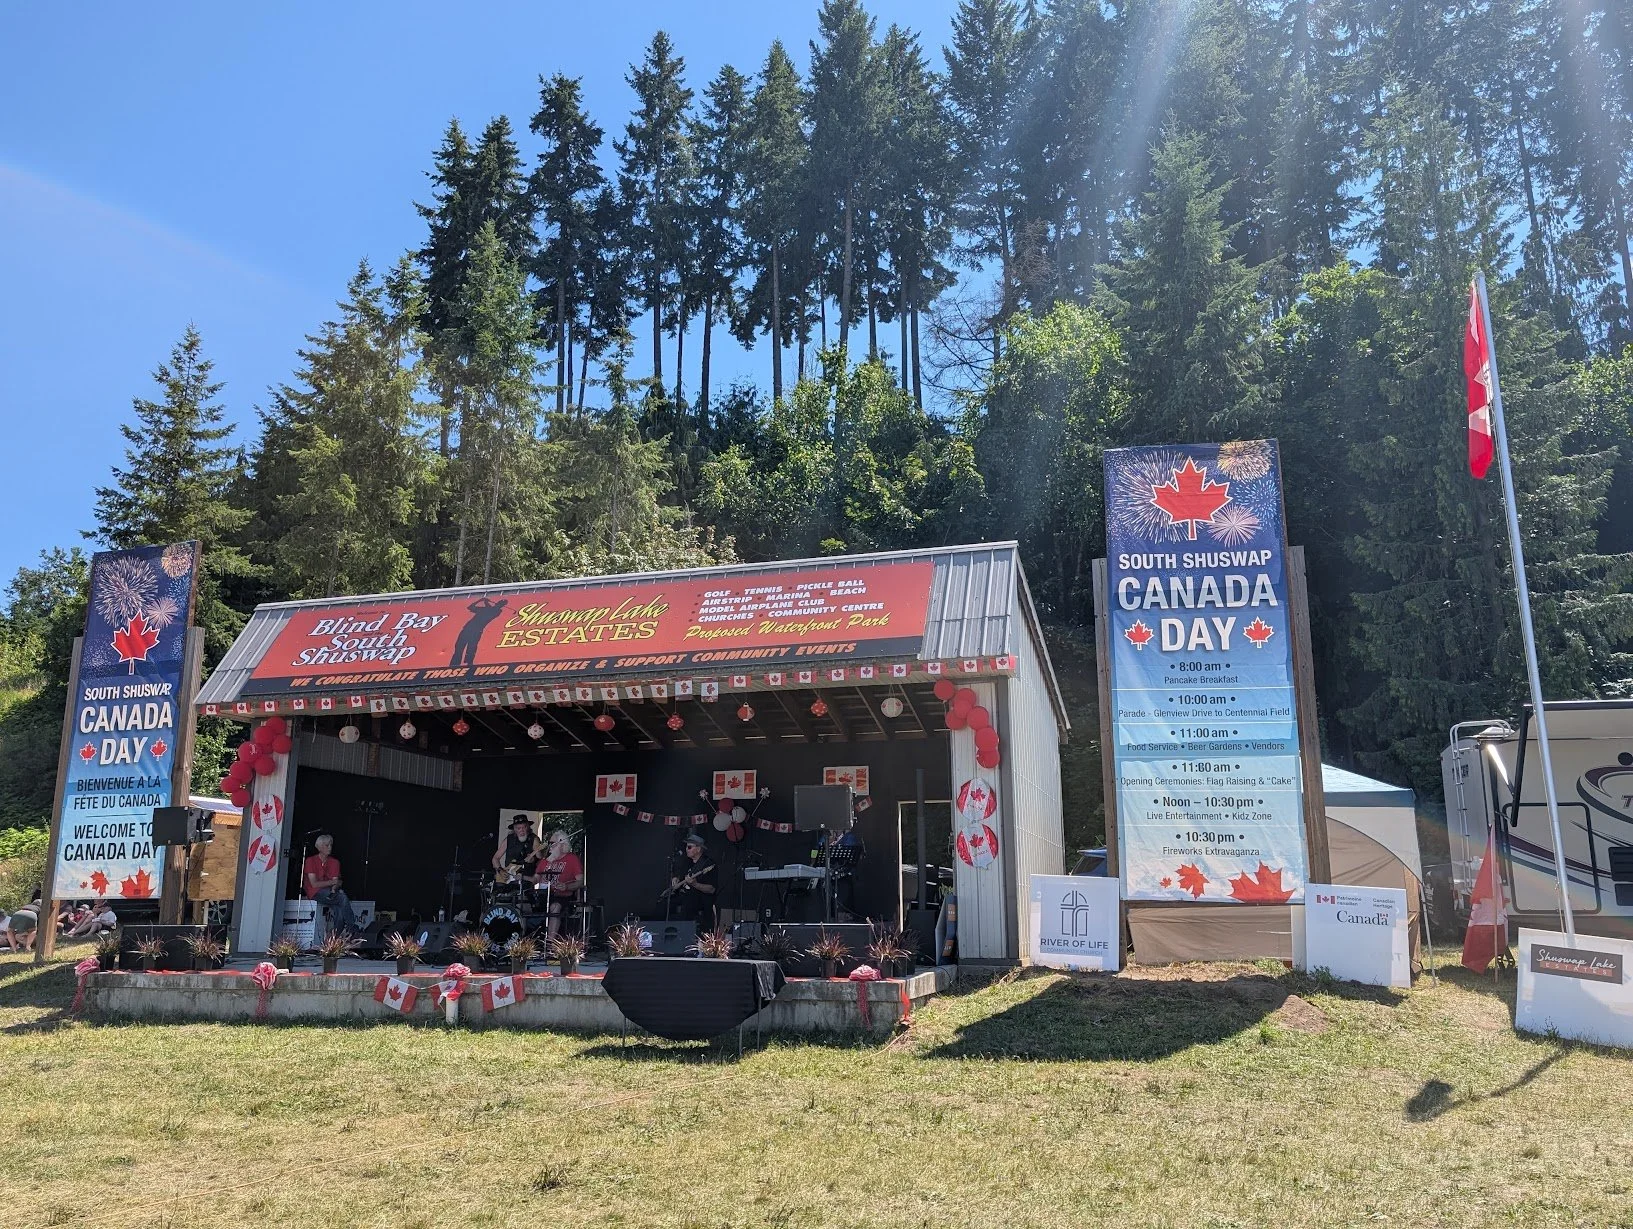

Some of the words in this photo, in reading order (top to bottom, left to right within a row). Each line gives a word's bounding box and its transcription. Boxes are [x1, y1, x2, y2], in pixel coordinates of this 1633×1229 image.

[1119, 553, 1177, 570] SOUTH
[1183, 550, 1272, 569] SHUSWAP
[702, 596, 752, 606] AIRSTRIP
[766, 592, 811, 601] MARINA
[830, 587, 867, 596] BEACH
[704, 590, 731, 598] GOLF
[744, 586, 783, 595] TENNIS
[796, 581, 833, 590] PICKLE
[1118, 573, 1278, 610] CANADA
[504, 602, 611, 629] Shuswap
[609, 593, 670, 621] Lake
[698, 613, 754, 623] CHURCHES
[768, 606, 837, 618] COMMUNITY
[841, 602, 885, 612] CENTRE
[699, 605, 735, 614] MODEL
[739, 601, 794, 612] AIRPLANE
[798, 598, 825, 607] CLUB
[307, 613, 390, 636] Blind
[391, 612, 448, 633] Bay
[683, 623, 755, 641] Proposed
[758, 617, 843, 637] Waterfront
[846, 612, 892, 630] Park
[325, 628, 409, 652] South
[495, 621, 659, 648] ESTATES
[1161, 616, 1237, 651] DAY
[292, 646, 416, 666] Shuswap
[290, 677, 312, 687] WE
[315, 671, 420, 686] CONGRATULATE
[422, 667, 470, 680] THOSE
[473, 665, 509, 676] WHO
[513, 660, 591, 674] ORGANIZE
[595, 659, 607, 669] &
[613, 654, 688, 668] SUPPORT
[691, 648, 790, 664] COMMUNITY
[795, 643, 857, 656] EVENTS
[1179, 661, 1202, 672] 8:00
[1164, 675, 1198, 684] Pancake
[1200, 675, 1239, 684] Breakfast
[84, 686, 120, 701] SOUTH
[1178, 694, 1208, 705] 10:00
[1209, 696, 1227, 705] am
[80, 701, 173, 733] CANADA
[1118, 709, 1146, 718] Parade
[1154, 709, 1190, 718] Glenview
[1192, 708, 1213, 717] Drive
[1214, 709, 1223, 717] to
[1225, 708, 1268, 717] Centennial
[1270, 707, 1290, 716] Field
[1180, 728, 1210, 738] 11:00
[1211, 729, 1229, 738] am
[100, 736, 149, 765] DAY
[1127, 743, 1146, 751] Food
[1148, 743, 1178, 751] Service
[1187, 742, 1206, 751] Beer
[1209, 742, 1242, 750] Gardens
[1251, 741, 1285, 750] Vendors
[1213, 763, 1231, 773] am
[77, 776, 135, 792] BIENVENUE
[147, 776, 161, 788] LA
[1120, 777, 1153, 786] Opening
[1155, 777, 1205, 786] Ceremonies:
[1206, 777, 1224, 787] Flag
[1226, 777, 1256, 786] Raising
[1258, 777, 1265, 785] &
[102, 795, 116, 809] DU
[119, 794, 161, 808] CANADA
[1162, 797, 1191, 807] Noon
[1204, 797, 1235, 808] 10:30
[1236, 798, 1254, 809] pm
[1146, 812, 1163, 820] Live
[1165, 812, 1222, 821] Entertainment
[1232, 812, 1250, 821] Kidz
[1251, 812, 1272, 821] Zone
[74, 822, 136, 840] WELCOME
[140, 822, 154, 837] TO
[1185, 832, 1216, 842] 10:30
[1217, 833, 1235, 844] pm
[64, 842, 126, 862] CANADA
[132, 841, 158, 860] DAY
[1162, 847, 1203, 856] Fireworks
[1205, 847, 1260, 858] Extravaganza
[483, 907, 504, 926] BLIND
[505, 908, 519, 925] BAY
[1336, 910, 1389, 926] Canada
[1040, 938, 1070, 948] RIVER
[1072, 940, 1086, 948] OF
[1088, 940, 1109, 950] LIFE
[1536, 949, 1588, 968] Shuswap
[1589, 957, 1617, 970] Lake
